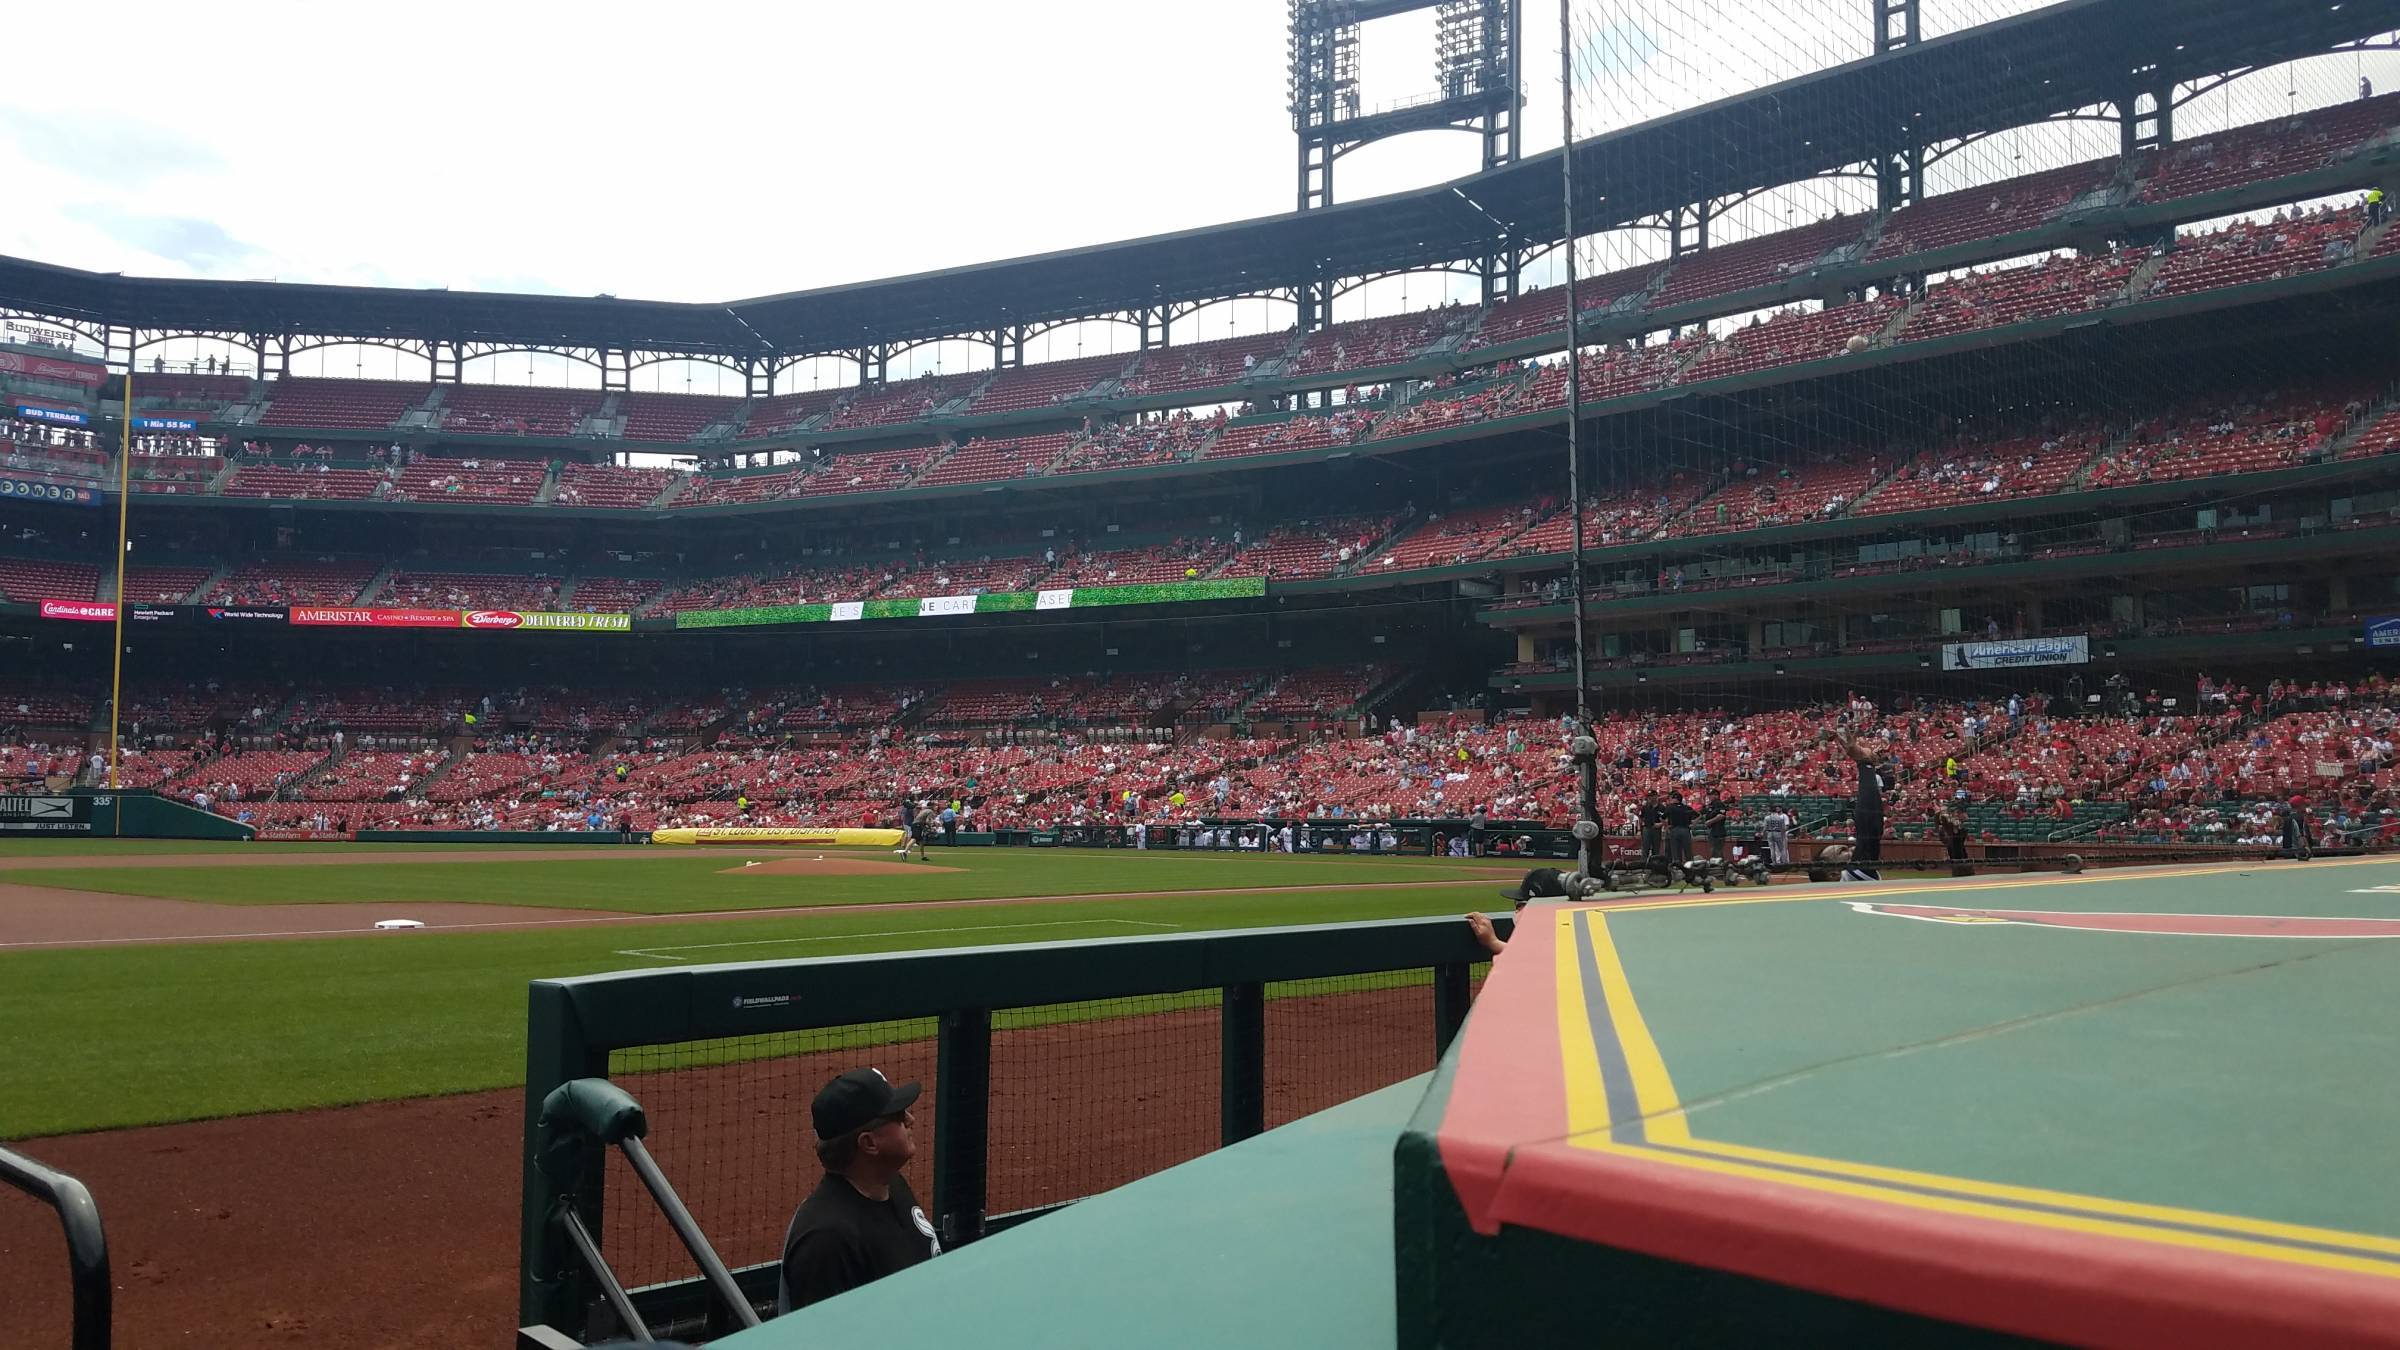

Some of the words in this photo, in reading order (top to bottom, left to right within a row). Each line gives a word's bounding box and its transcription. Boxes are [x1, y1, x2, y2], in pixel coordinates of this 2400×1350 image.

[6, 321, 77, 341] BUDWEISER
[25, 408, 43, 417] BUD
[45, 411, 81, 422] TERRACE
[179, 421, 192, 429] Sec
[44, 602, 79, 615] Cardinals
[87, 607, 115, 617] CARE
[297, 610, 372, 622] AMERISTAR
[526, 614, 586, 627] DELIVERED
[589, 616, 629, 628] FRESH
[1995, 655, 2032, 665] CREDIT
[2034, 652, 2068, 663] UNION
